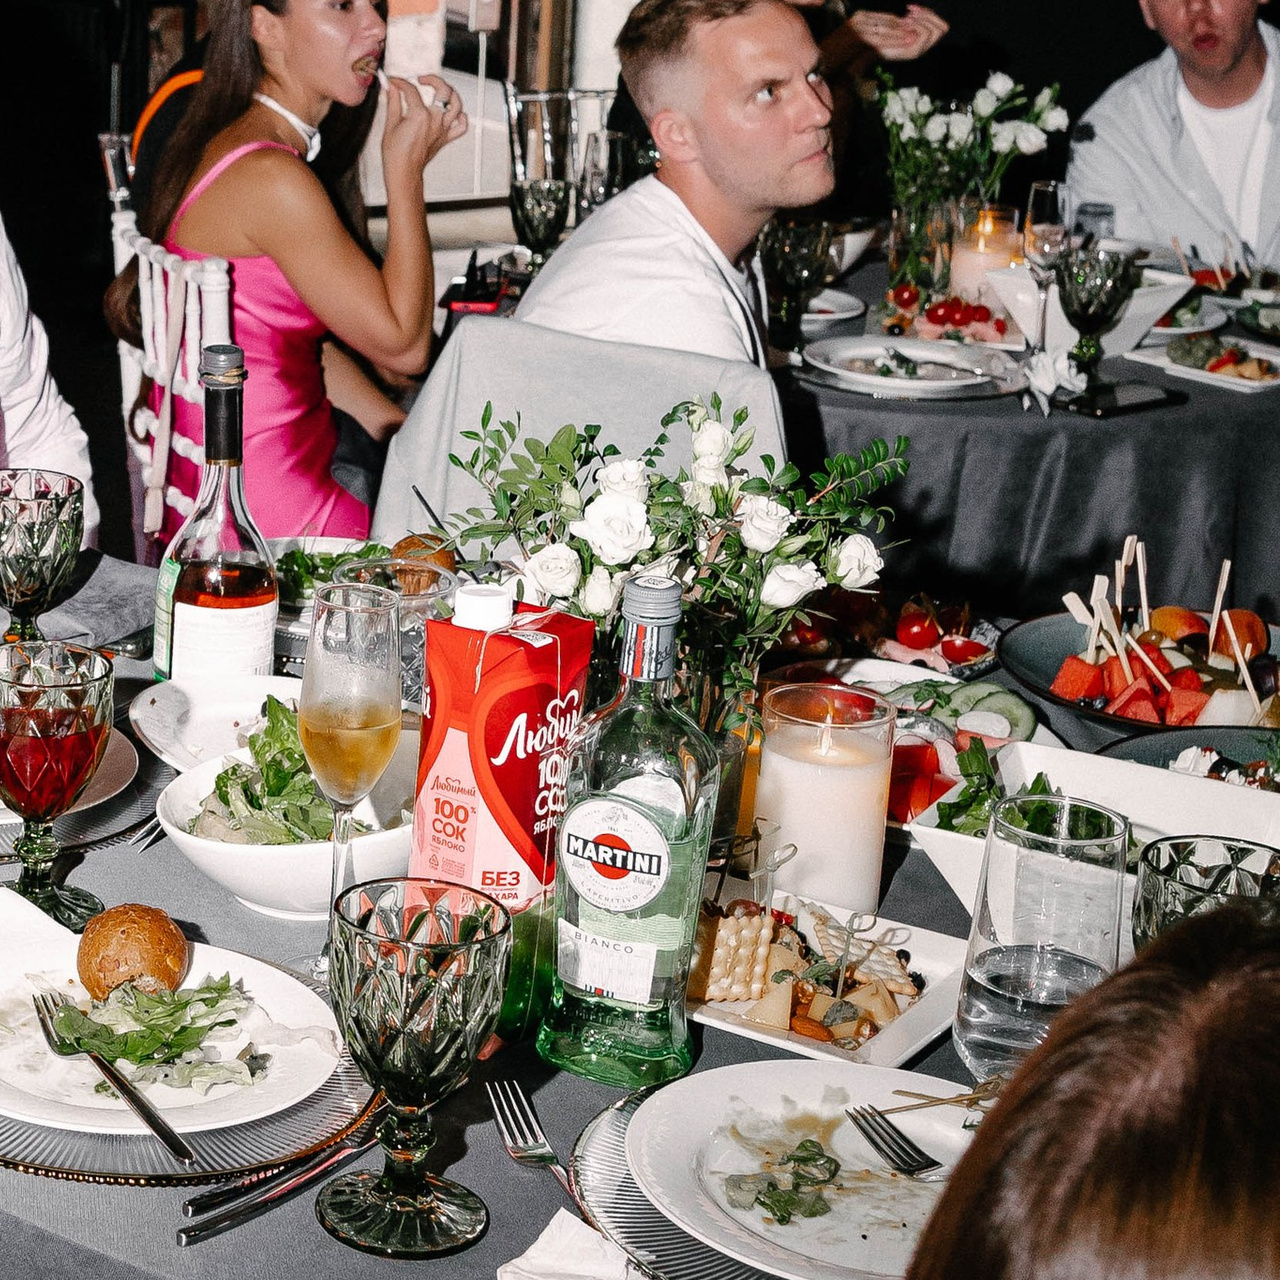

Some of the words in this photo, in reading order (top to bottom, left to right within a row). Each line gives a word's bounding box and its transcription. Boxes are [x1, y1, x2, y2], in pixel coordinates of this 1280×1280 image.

[490, 689, 582, 766] Любим
[430, 775, 476, 797] Любимый
[432, 818, 467, 842] СОК
[533, 816, 557, 836] ЯБЛО
[431, 834, 466, 853] ЯБЛОКО
[569, 836, 658, 874] MARTINI
[481, 870, 521, 887] БЕЗ
[488, 892, 519, 901] АХАРА
[574, 931, 634, 955] BIANCO
